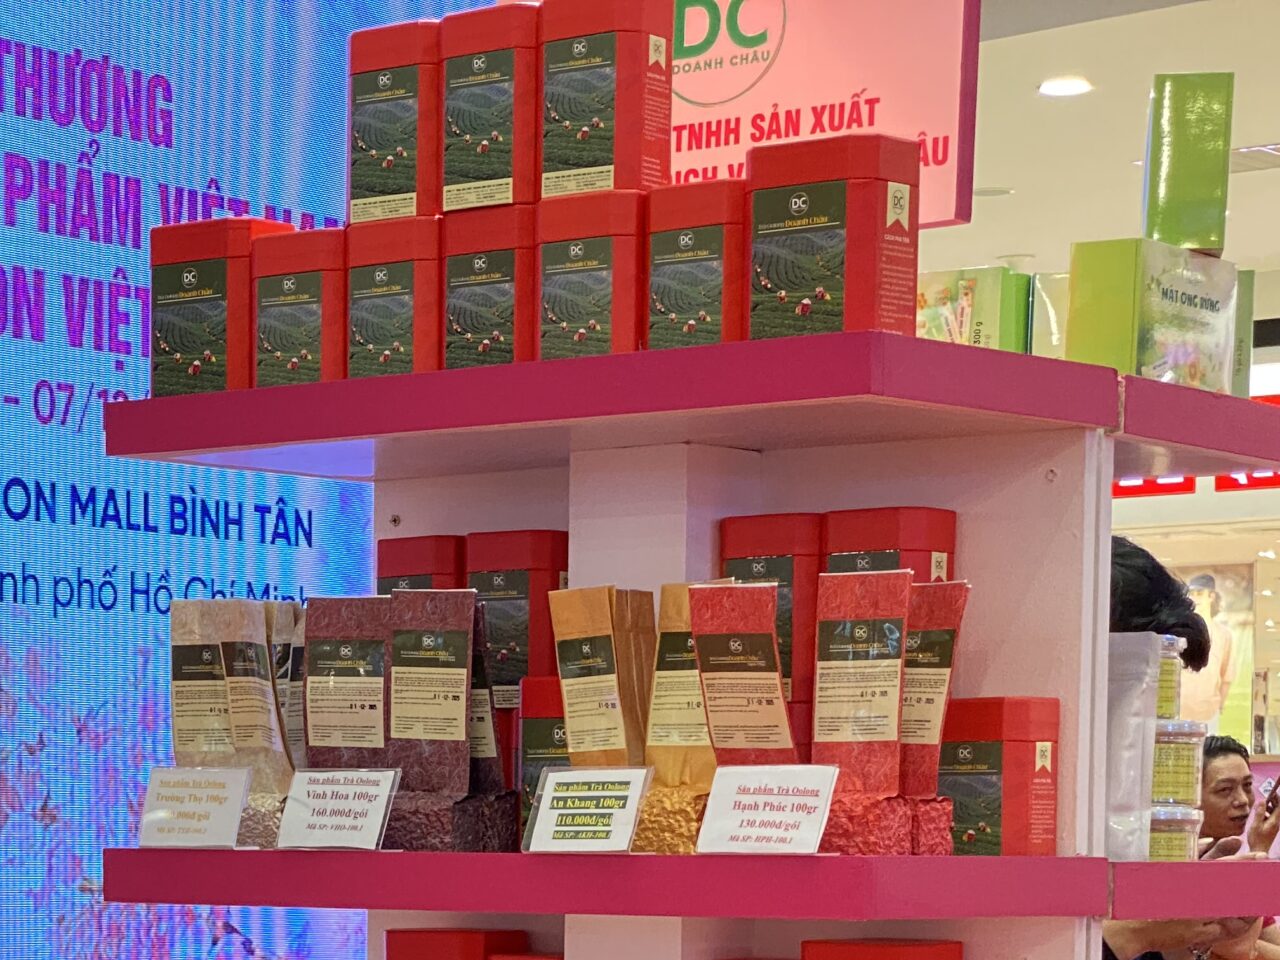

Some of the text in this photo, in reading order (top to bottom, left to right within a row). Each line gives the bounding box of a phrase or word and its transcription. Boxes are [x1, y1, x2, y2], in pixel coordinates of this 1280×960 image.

[673, 0, 768, 60] DC
[672, 50, 771, 75] DOANH CHÂU
[672, 88, 880, 153] TNHH SẢN XUẤT
[3, 139, 142, 249] PHẨM
[791, 197, 807, 209] DC
[69, 483, 158, 534] MALL
[169, 486, 243, 542] BÌNH
[255, 496, 313, 548] TÂN
[53, 564, 117, 619] phố
[129, 569, 171, 615] Hồ
[307, 775, 381, 786] Sản phẩm Trà Oolong
[555, 782, 630, 792] Sản phẩm Trà Oolong
[736, 783, 820, 796] Sản phẩm Trà Oolong
[330, 790, 349, 800] Hoa
[352, 791, 380, 803] 100gr
[551, 798, 625, 809] An Khang 100gr
[732, 801, 819, 815] Hạnh Phúc 100gr
[310, 807, 369, 820] 160.000đ/gói
[557, 815, 612, 828] 110.000đ/gói
[738, 819, 801, 831] 130.000đ/gói
